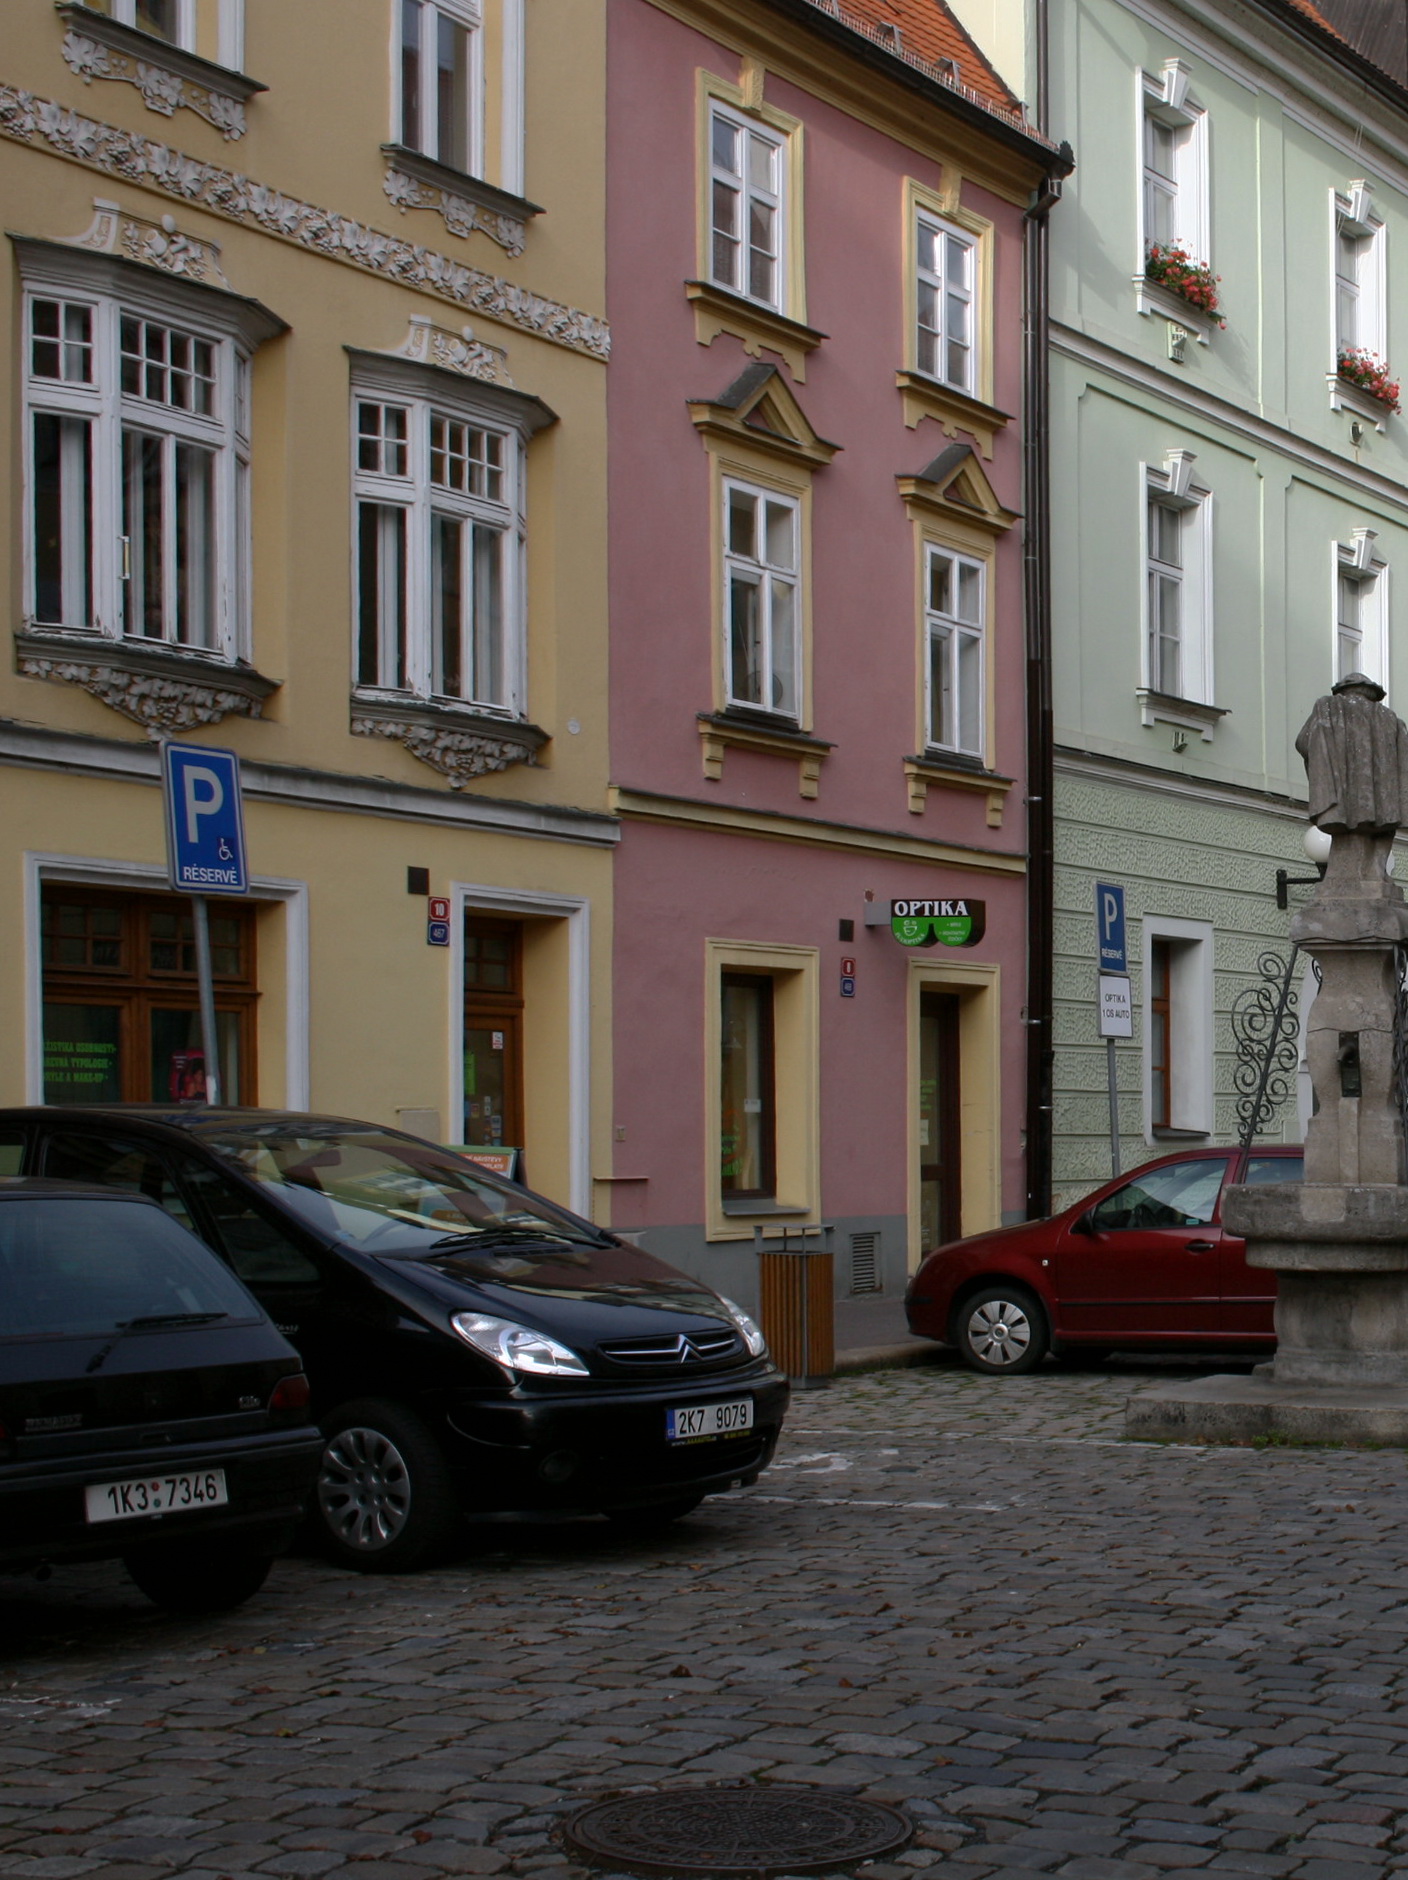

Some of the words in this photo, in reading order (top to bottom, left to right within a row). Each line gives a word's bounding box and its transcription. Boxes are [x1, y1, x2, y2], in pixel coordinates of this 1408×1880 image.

[183, 764, 223, 843] P
[434, 903, 445, 916] 10
[894, 901, 969, 916] OPTIKA
[1103, 893, 1118, 940] P
[1104, 993, 1126, 1003] OPTIKA
[1115, 1010, 1130, 1019] AUTO
[678, 1409, 705, 1435] 2K7
[716, 1404, 747, 1429] 9079
[108, 1482, 149, 1514] 1K3
[165, 1473, 217, 1507] 7346
